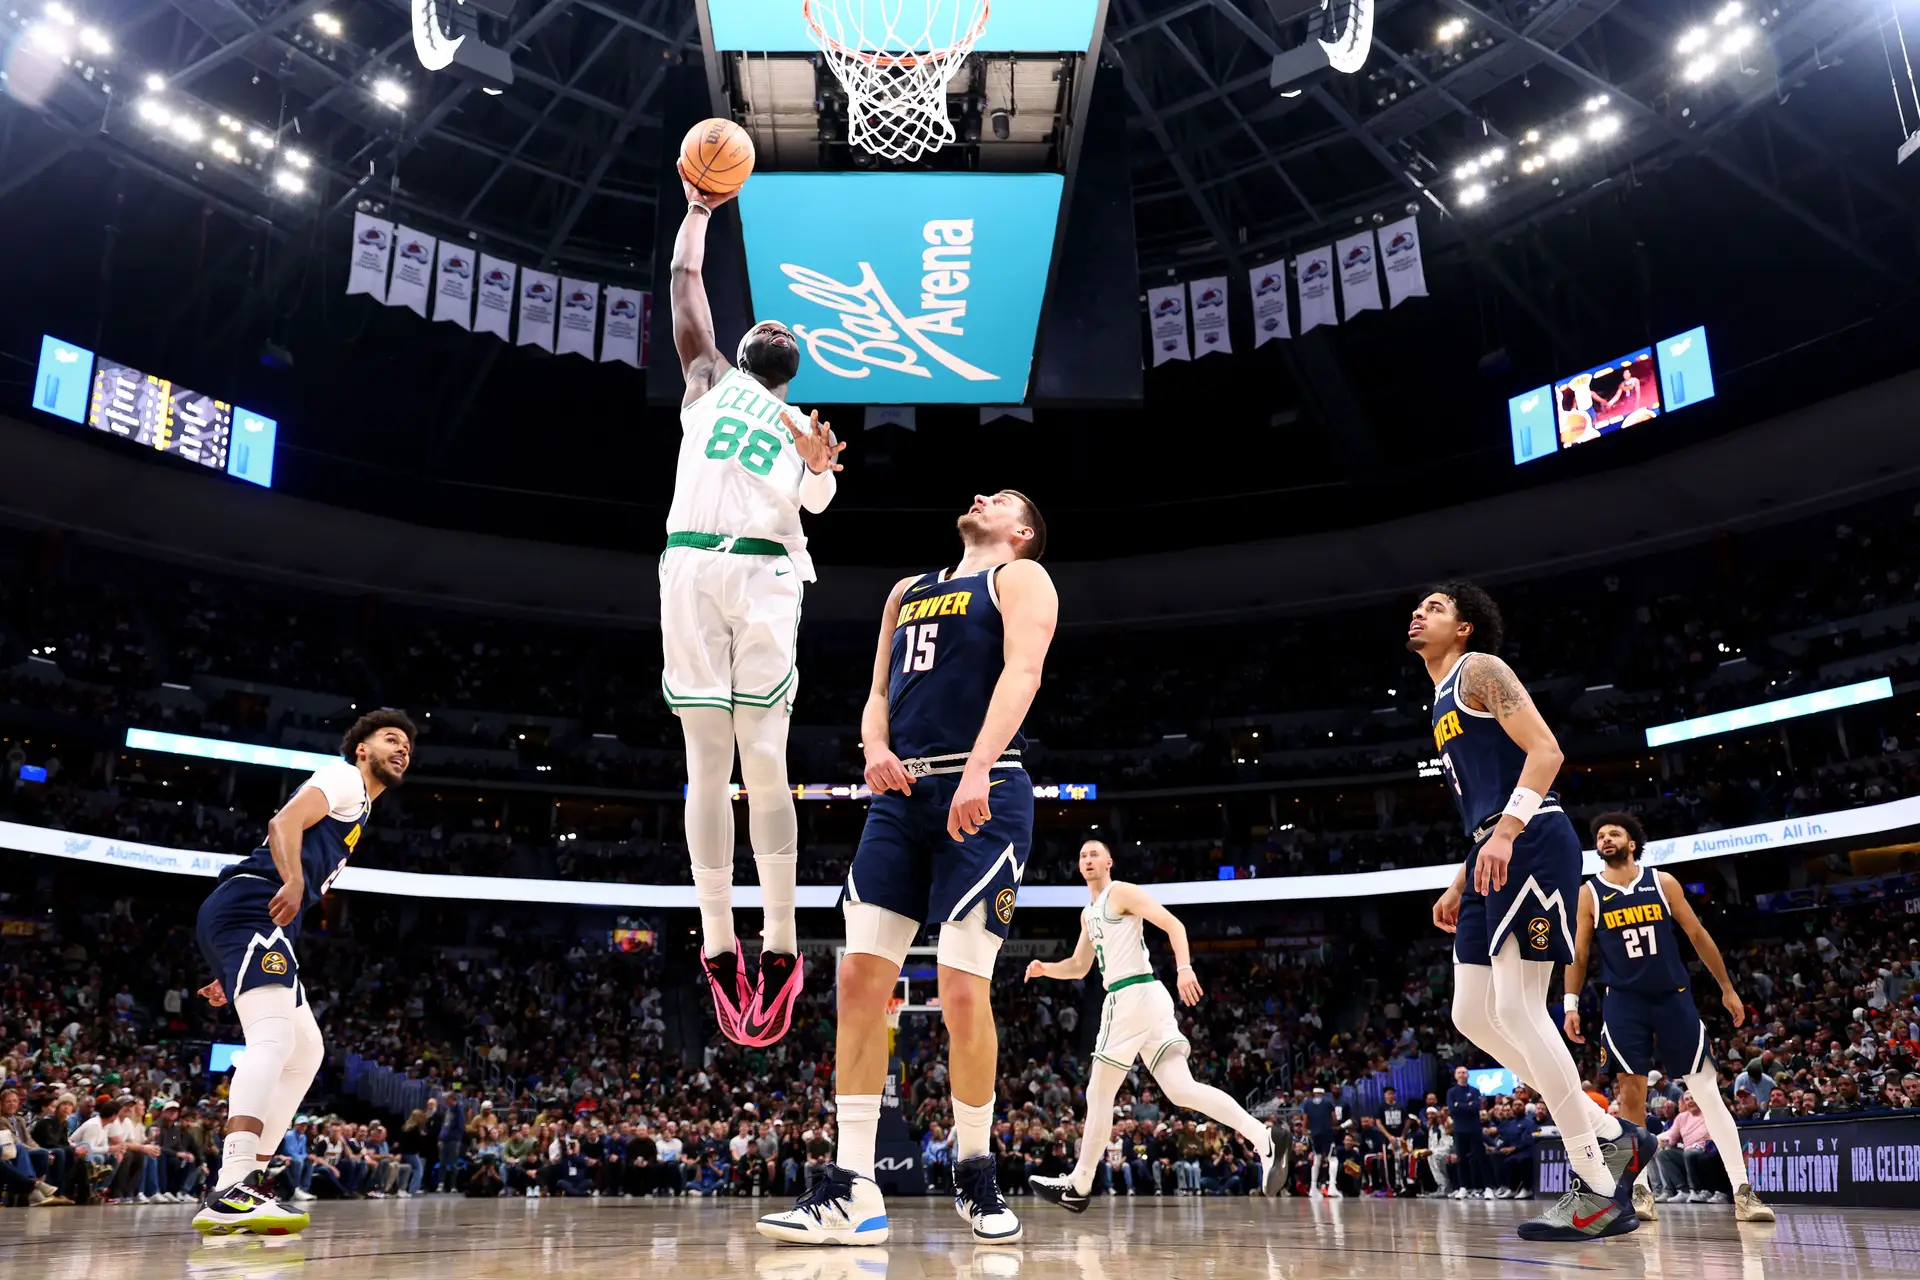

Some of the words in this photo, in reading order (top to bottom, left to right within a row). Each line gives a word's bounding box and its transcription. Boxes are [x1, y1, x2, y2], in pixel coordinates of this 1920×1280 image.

[918, 218, 974, 336] Arena
[780, 262, 1001, 381] Ball
[704, 416, 782, 476] 88
[896, 591, 973, 629] DENVER
[902, 623, 939, 674] 15
[1692, 831, 1774, 854] Aluminum.
[1782, 823, 1804, 840] All
[1806, 821, 1828, 837] in.
[190, 857, 211, 870] All
[1603, 903, 1664, 930] DENVER
[1004, 944, 1046, 954] SUITS
[1621, 925, 1658, 959] 27
[1748, 1139, 1800, 1155] BUILT
[1816, 1137, 1839, 1152] BY
[1850, 1146, 1875, 1182] NBA
[1748, 1155, 1785, 1193] BLACK
[1786, 1154, 1839, 1193] HISTORY
